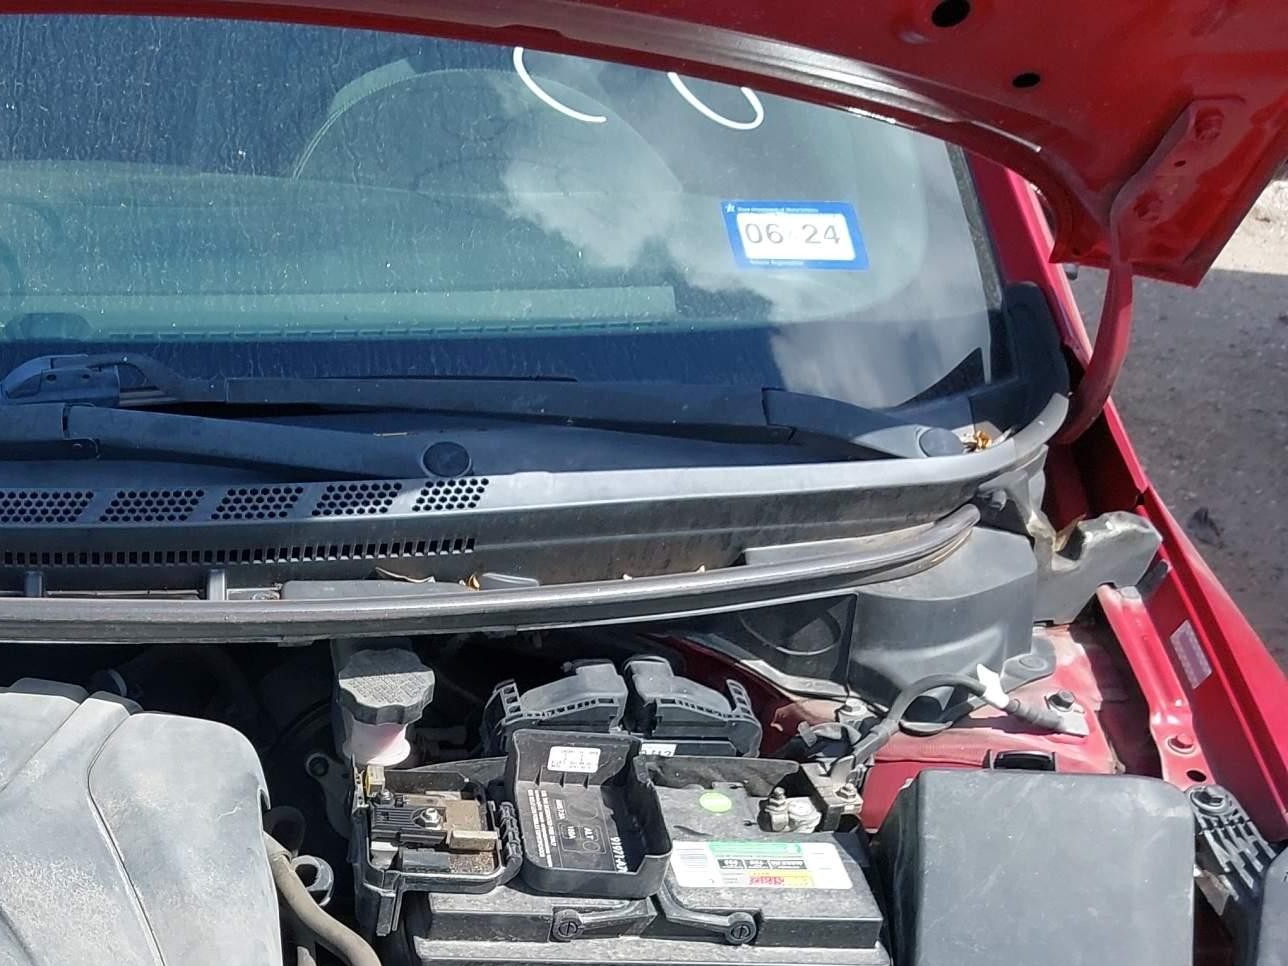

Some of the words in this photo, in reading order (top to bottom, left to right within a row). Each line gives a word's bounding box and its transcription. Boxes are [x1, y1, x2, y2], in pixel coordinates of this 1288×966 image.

[744, 223, 784, 244] 06
[801, 224, 841, 244] 24
[584, 827, 594, 841] ALT
